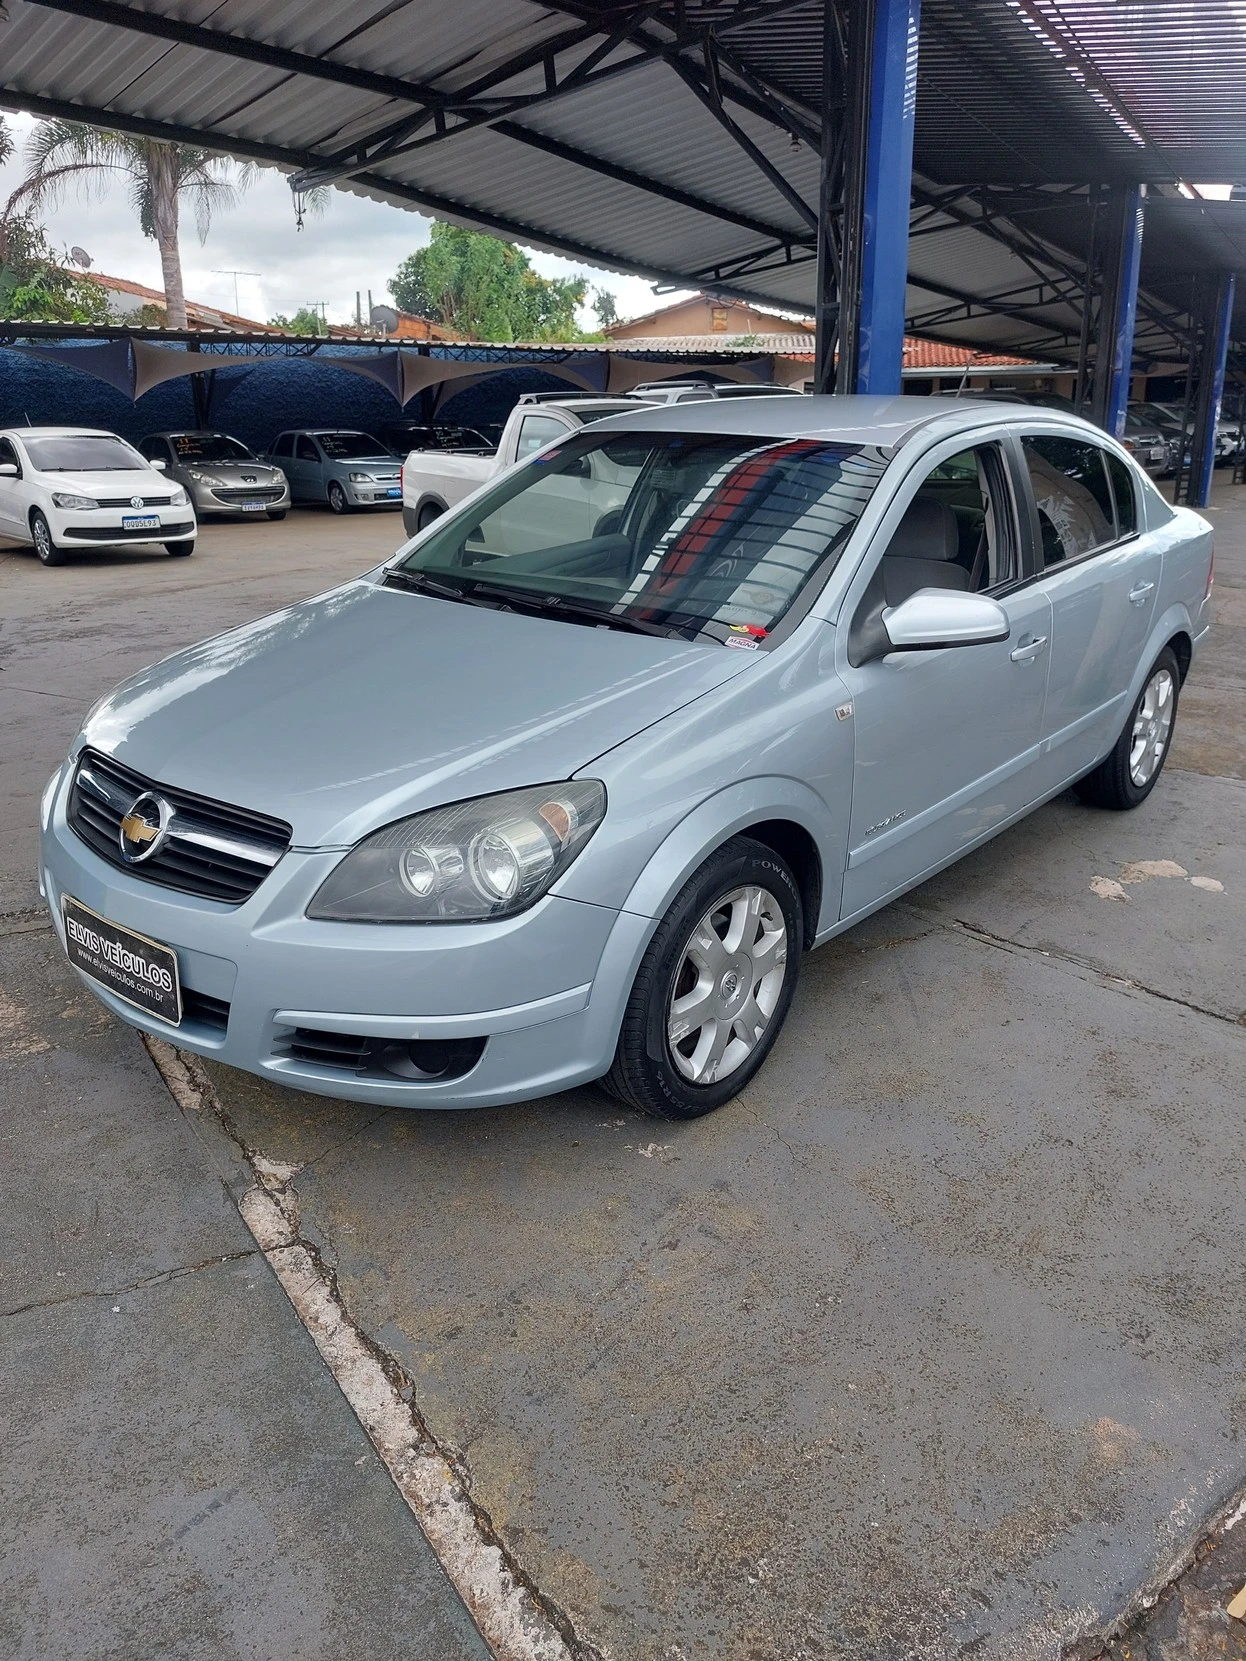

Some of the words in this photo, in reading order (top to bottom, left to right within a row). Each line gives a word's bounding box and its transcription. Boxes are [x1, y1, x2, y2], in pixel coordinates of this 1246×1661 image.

[728, 638, 757, 649] MAGNA
[67, 917, 100, 954] ELVIS
[100, 936, 172, 992] VEÍCULOS
[77, 947, 164, 1003] www.elvisveiculos.com.br
